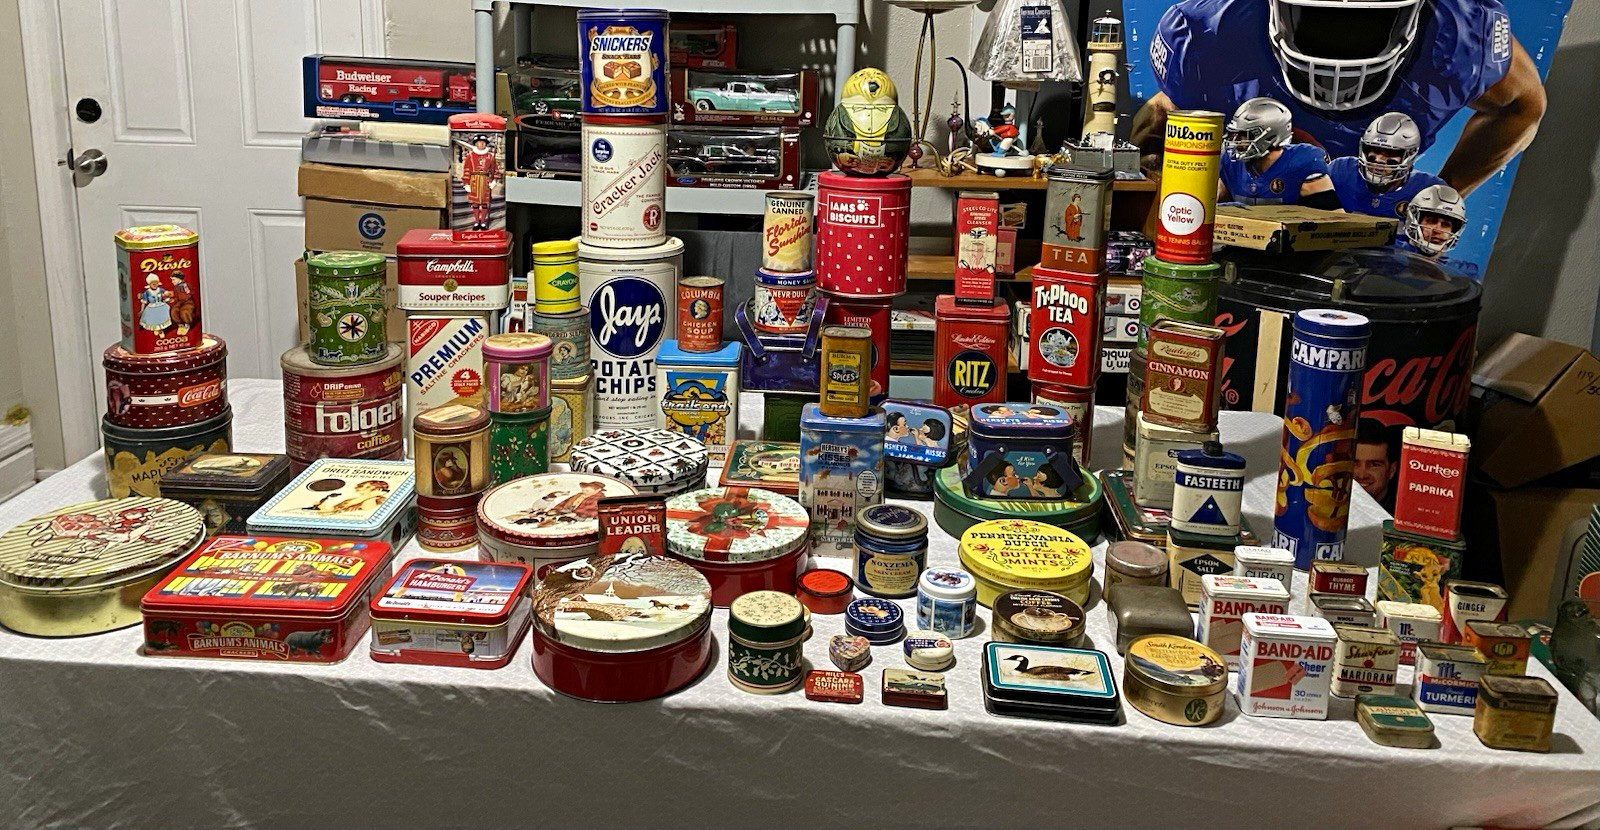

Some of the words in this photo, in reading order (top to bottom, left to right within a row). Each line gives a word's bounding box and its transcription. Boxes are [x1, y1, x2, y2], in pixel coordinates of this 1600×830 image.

[1493, 20, 1502, 54] BUD
[1500, 15, 1509, 59] LIGHT
[592, 37, 650, 52] SNICKERS
[336, 69, 392, 83] Budweiser
[349, 84, 378, 95] Racing
[1167, 124, 1214, 141] Wilson
[592, 175, 637, 215] Cracker
[638, 149, 662, 180] Jack
[771, 200, 806, 208] GENUINE
[830, 201, 856, 213] IAMS
[1169, 205, 1192, 216] Optic
[829, 212, 876, 225] BISCUITS
[1167, 214, 1194, 224] Yellow
[766, 215, 807, 242] Florida
[1052, 248, 1088, 265] TEA
[140, 257, 192, 273] Droste
[419, 293, 451, 303] Souper
[452, 293, 486, 303] Recipes
[680, 288, 721, 301] COLUMBIA
[600, 284, 661, 348] Jays
[1047, 306, 1074, 324] TEA
[413, 319, 437, 345] NABISCO
[687, 328, 713, 336] SOUP
[410, 317, 484, 388] PREMIUM
[1160, 344, 1201, 358] Rawleigh's
[1291, 339, 1366, 371] CAMPARI
[420, 369, 448, 396] SALTINE
[447, 333, 485, 369] CRACKERS
[591, 359, 654, 377] POTAT
[1149, 361, 1210, 380] CINNAMON
[460, 371, 471, 379] 4
[832, 371, 856, 382] SPICES
[955, 359, 991, 388] RITZ
[596, 376, 656, 394] CHIPS
[182, 383, 219, 404] Coca-Cola
[316, 399, 403, 438] Folger
[357, 434, 390, 450] coffee
[822, 444, 849, 454] HERSHEY'S
[818, 453, 851, 463] KISSES
[884, 443, 908, 453] RSHEY'S
[925, 447, 946, 459] KISSES
[1408, 459, 1460, 478] Durkee
[1184, 475, 1240, 490] FASTEETH
[1408, 482, 1454, 498] PAPRIKA
[610, 514, 657, 526] UNION
[606, 524, 661, 536] LEADER
[970, 532, 1075, 544] PENNSYLVANIA
[1004, 539, 1049, 548] DUTCH
[219, 550, 294, 561] BARNUM'S
[294, 553, 354, 565] ANIMALS
[1000, 551, 1064, 560] BUTTER
[1316, 543, 1344, 562] CA
[871, 559, 914, 568] NOXZEMA
[1006, 558, 1060, 567] MINTS
[1193, 558, 1220, 567] EPSOM
[415, 573, 473, 585] McDonald's
[1244, 569, 1285, 582] CURAD
[408, 580, 467, 591] HAMBURGERS
[1328, 582, 1356, 592] THYME
[1457, 601, 1486, 613] GINGER
[193, 636, 242, 649] BARNUM'S
[242, 638, 286, 653] ANIMALS
[1257, 641, 1334, 661] BAND-AID
[1345, 645, 1395, 660] Shurfine
[1300, 660, 1327, 674] Sheer
[815, 676, 855, 685] CASCARA
[1341, 669, 1393, 683] MARJORAM
[815, 681, 855, 691] QUININE
[1294, 689, 1306, 698] 30
[1426, 691, 1475, 705] TURMERI
[1252, 702, 1285, 715] Johnson
[1290, 704, 1324, 717] Johnson
